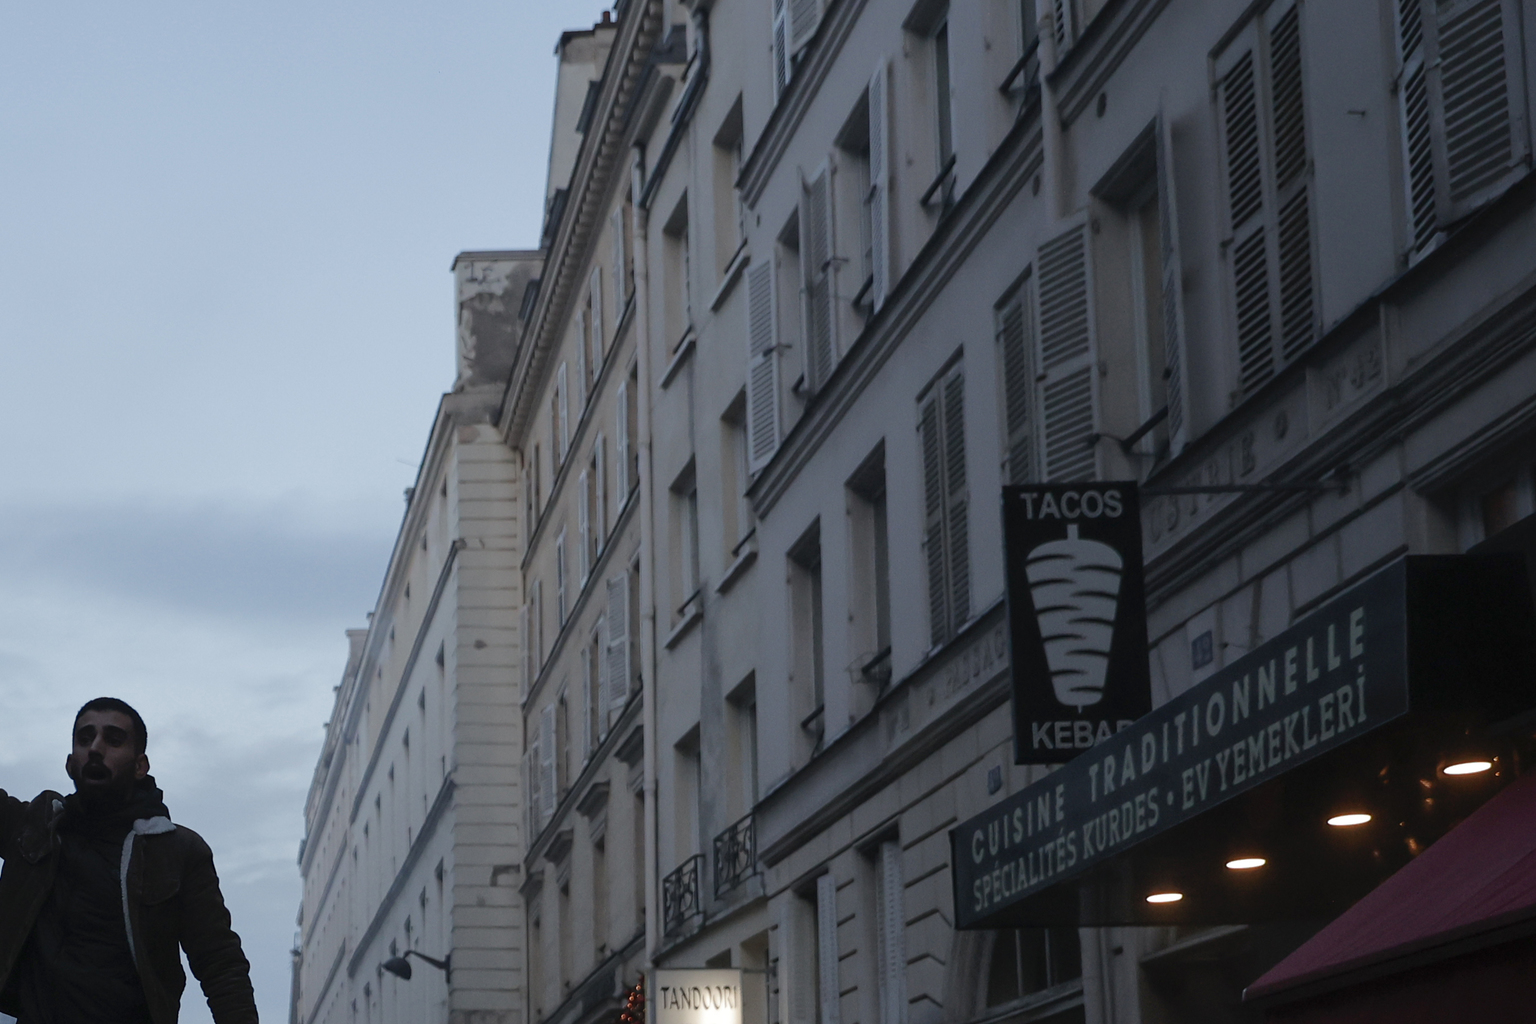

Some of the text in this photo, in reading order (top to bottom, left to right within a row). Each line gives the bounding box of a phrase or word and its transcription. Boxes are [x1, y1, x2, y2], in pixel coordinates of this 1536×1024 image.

[1020, 489, 1123, 519] TACOS
[972, 606, 1364, 864] CUISINE TRADITIONNELLE
[973, 664, 1366, 911] SPÉCIALITÉS KURDES EV YEMEKLERİ
[660, 985, 739, 1011] TANDOORI
